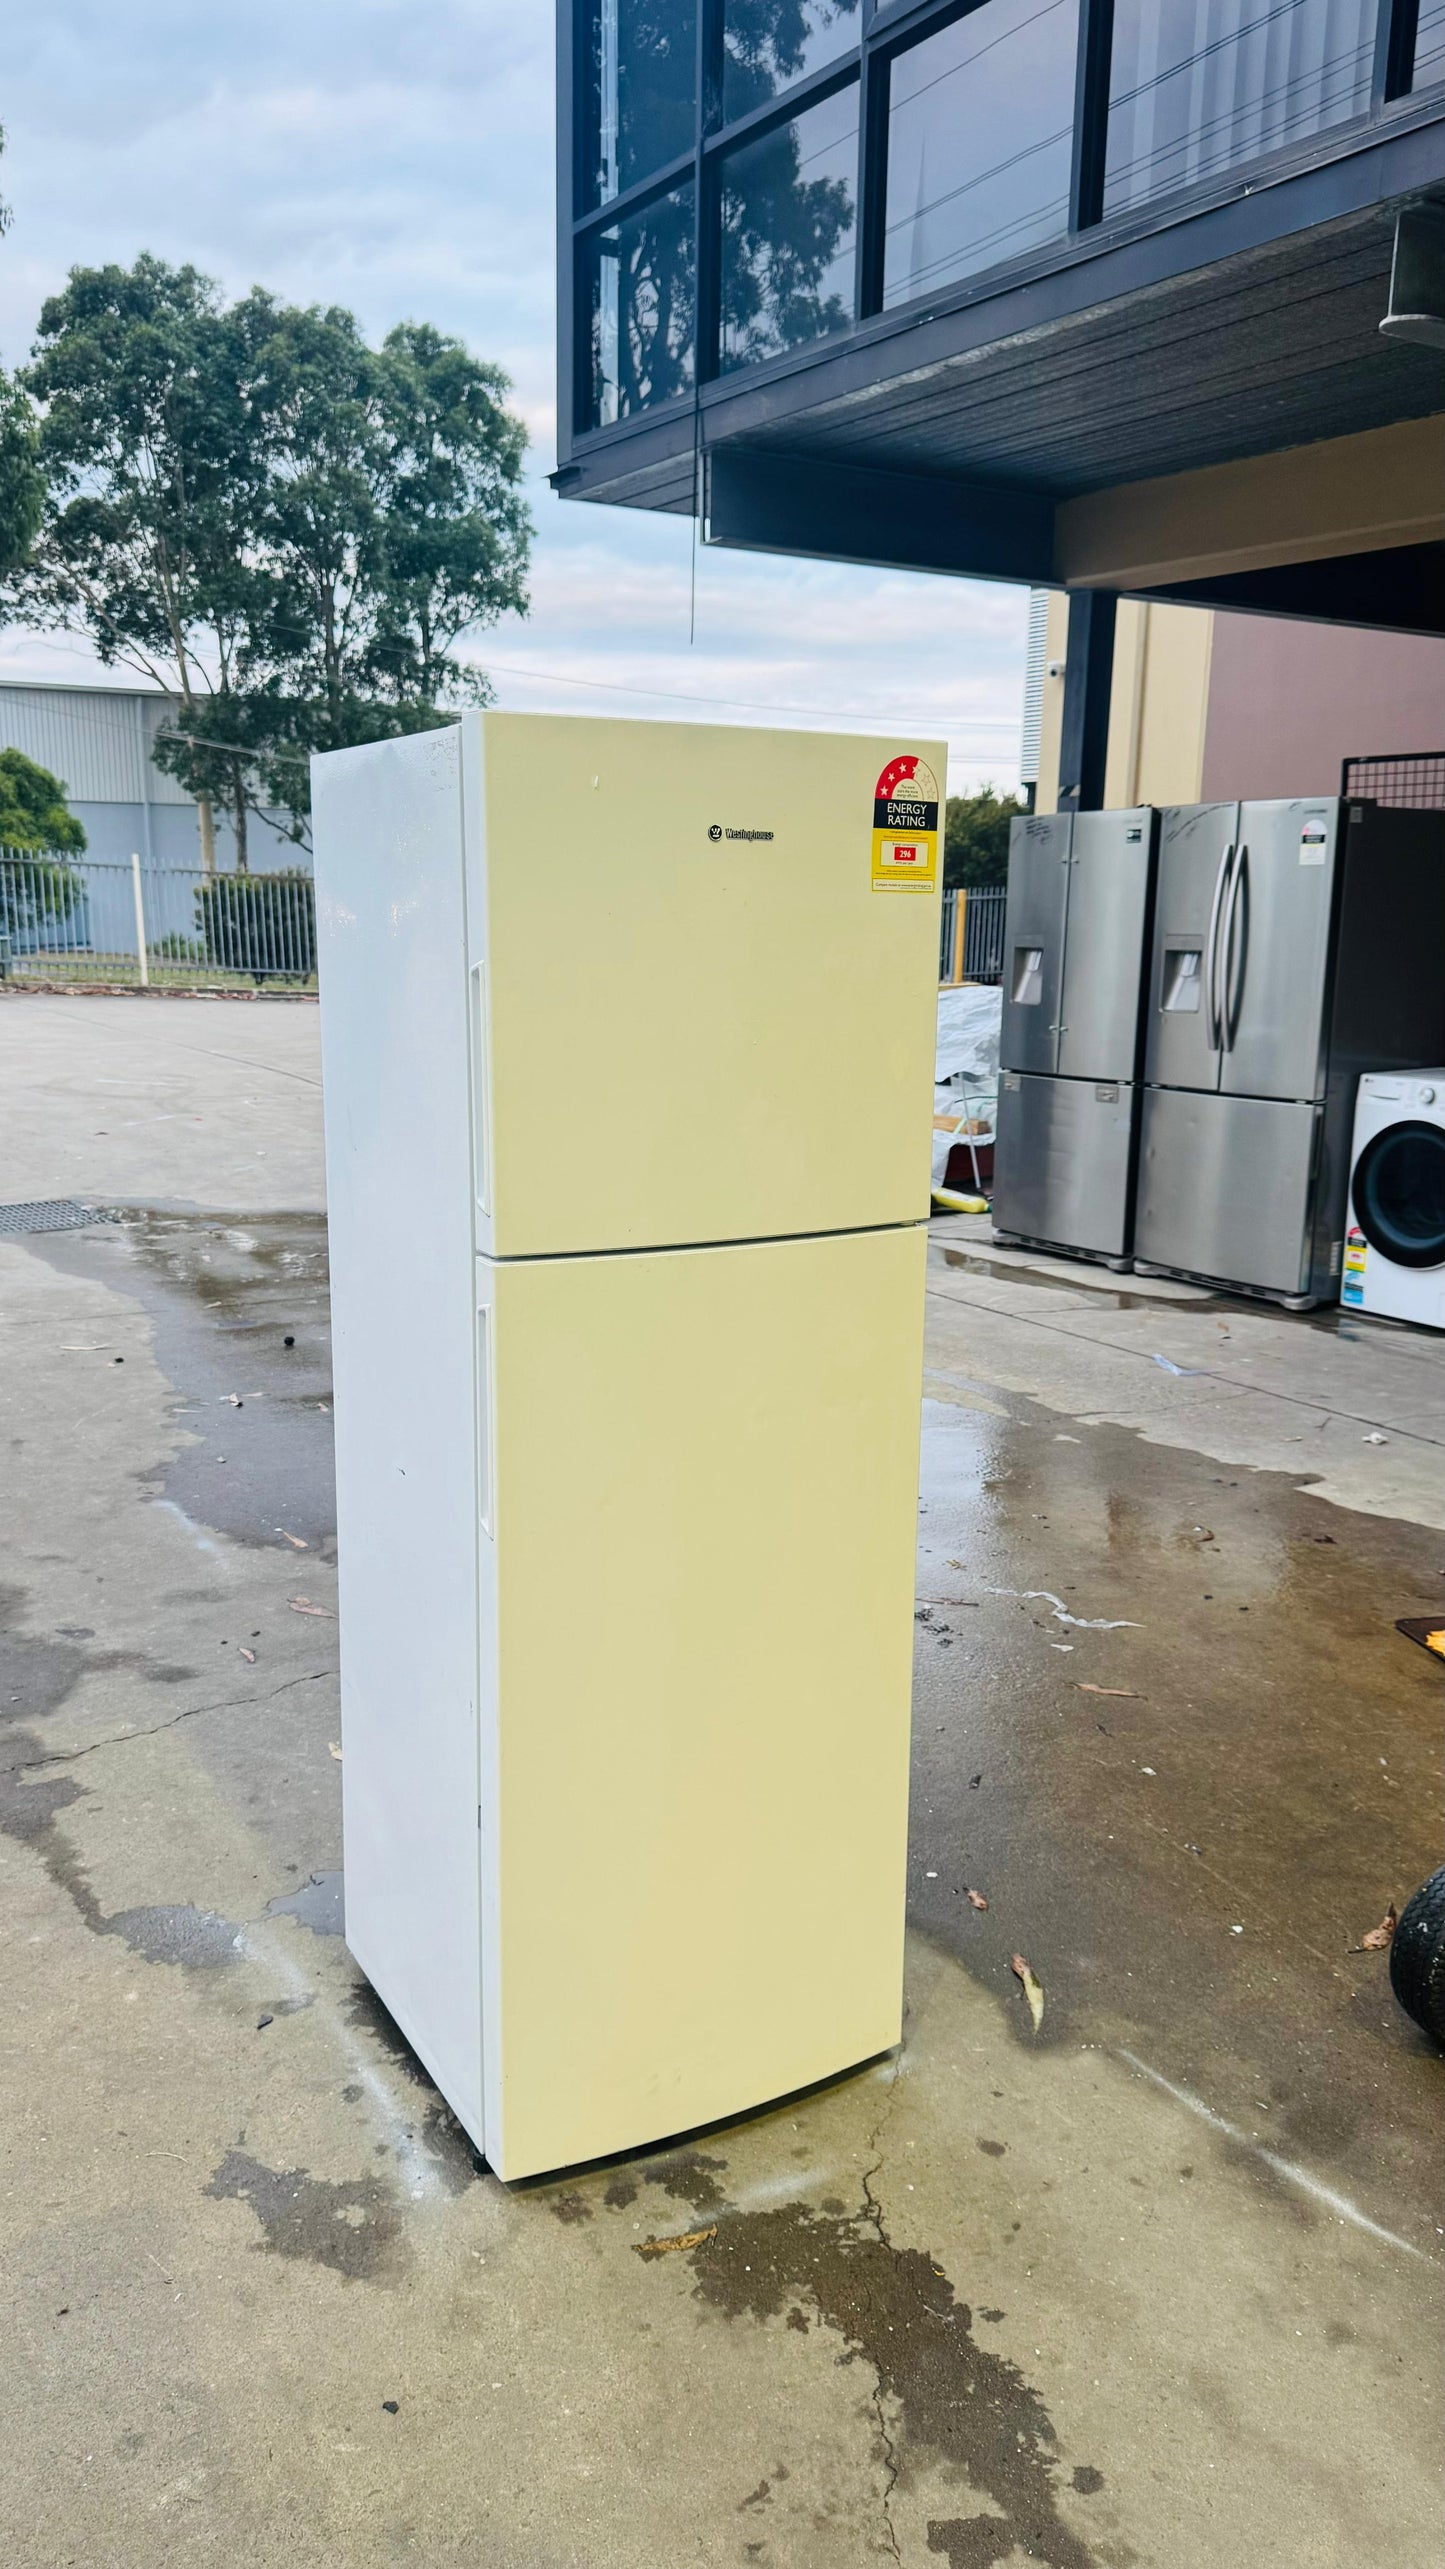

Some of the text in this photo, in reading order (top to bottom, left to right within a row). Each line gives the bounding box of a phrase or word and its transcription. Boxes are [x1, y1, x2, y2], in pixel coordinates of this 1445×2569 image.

[887, 802, 927, 815] ENERGY
[888, 814, 926, 827] RATING
[725, 828, 774, 842] Westinghouse
[900, 850, 912, 858] 296
